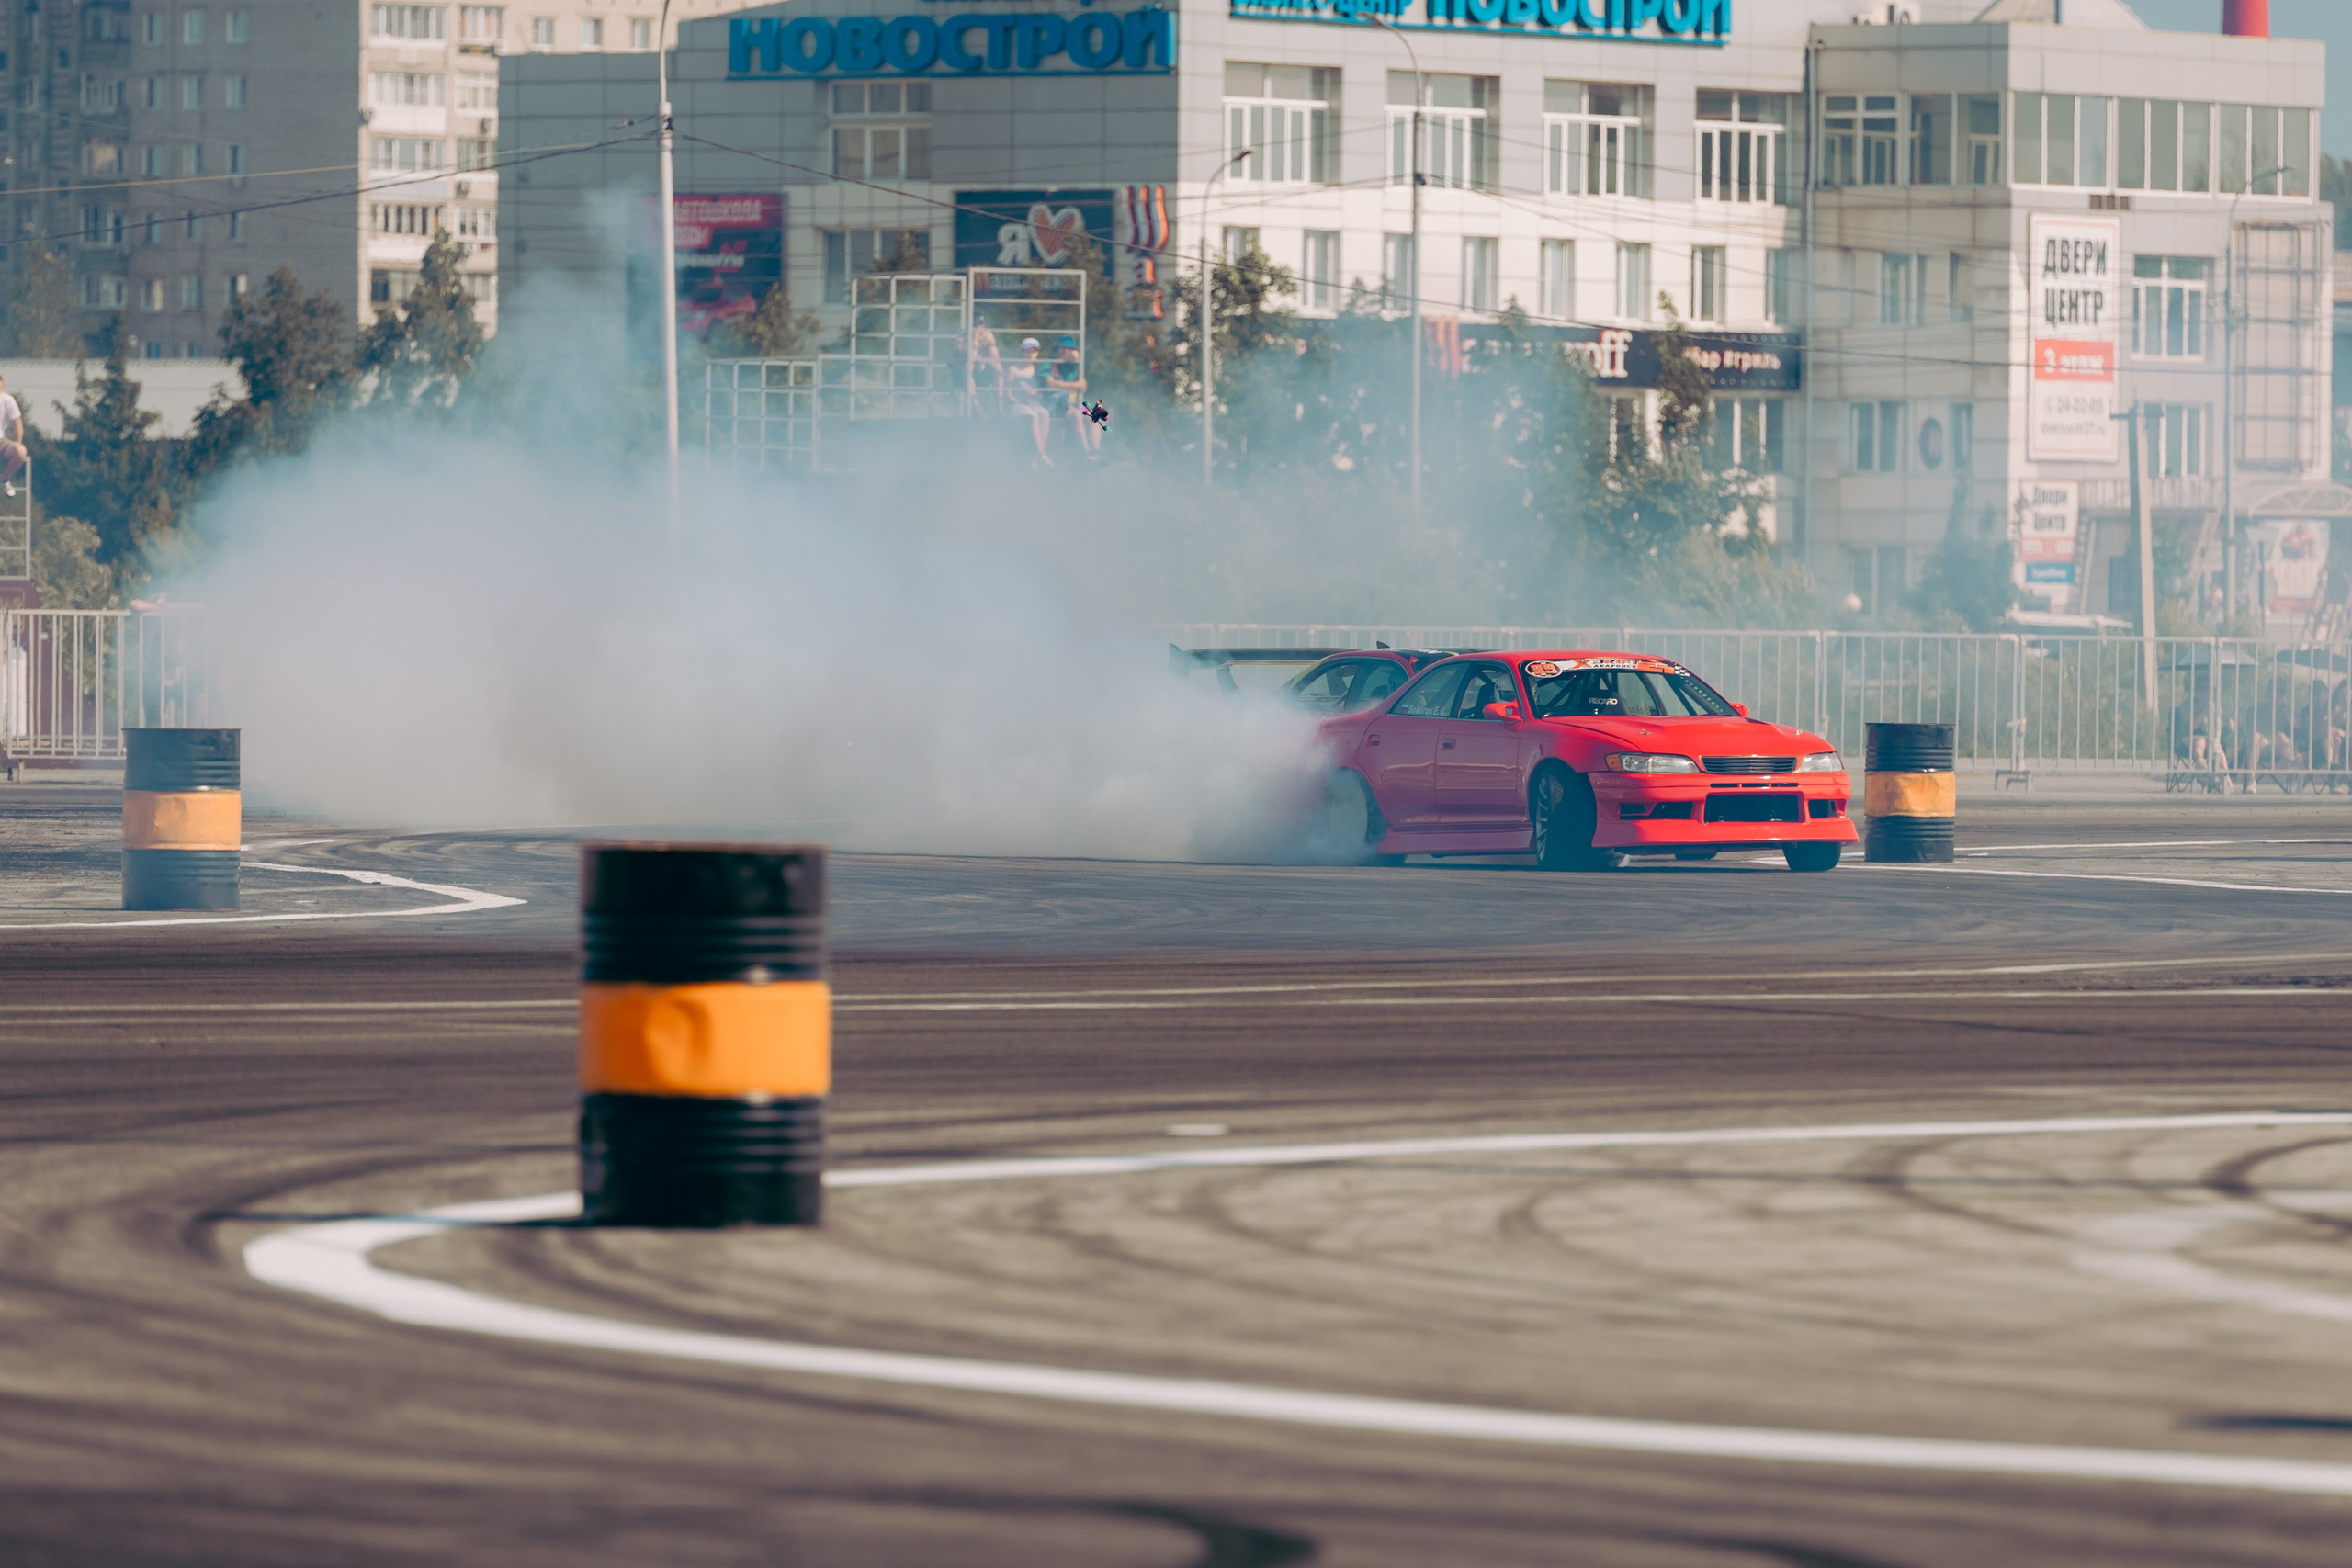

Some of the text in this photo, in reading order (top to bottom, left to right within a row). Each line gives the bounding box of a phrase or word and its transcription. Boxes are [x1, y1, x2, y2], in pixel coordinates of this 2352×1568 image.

[729, 3, 1177, 73] НОВОСТРОЙ
[2043, 238, 2107, 278] ДВЕРИ
[2044, 288, 2104, 328] ЦЕНТР
[2043, 347, 2105, 376] 3 этаж
[1589, 697, 1618, 705] RECARO
